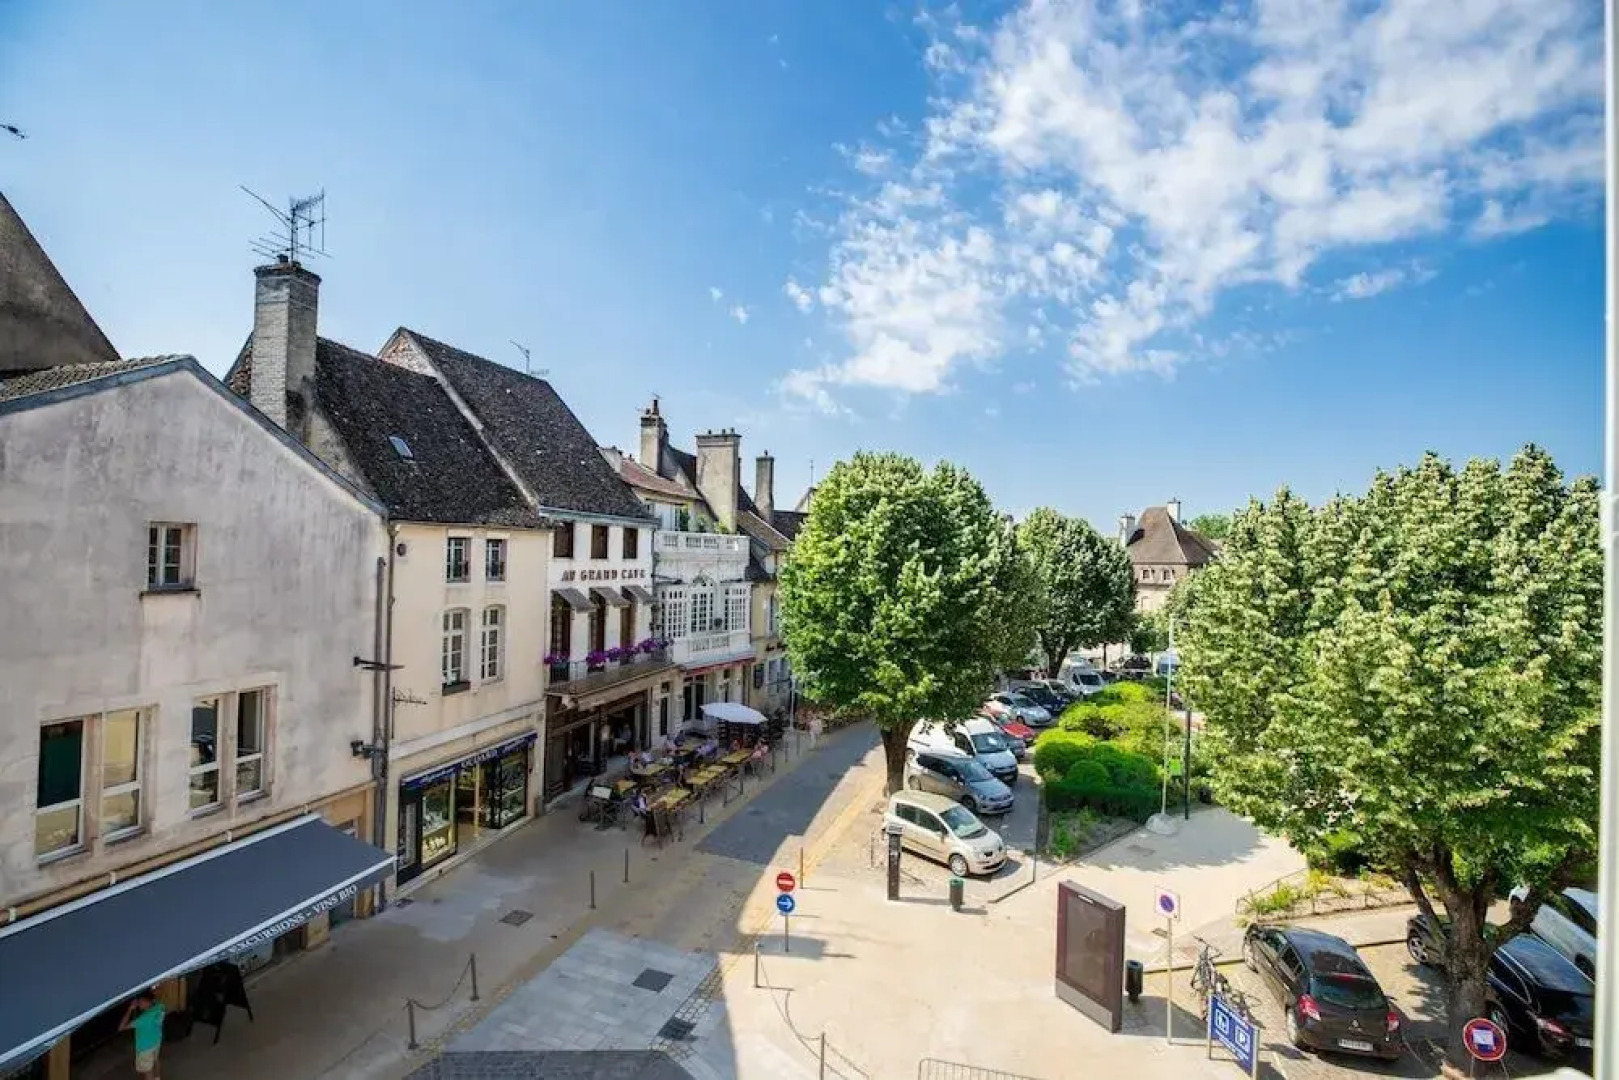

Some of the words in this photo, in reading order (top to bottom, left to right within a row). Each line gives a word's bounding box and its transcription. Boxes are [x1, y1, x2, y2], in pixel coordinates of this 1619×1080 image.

[562, 569, 576, 581] AU
[580, 569, 618, 581] GRAND
[228, 912, 305, 953] EXCURSIONS
[313, 895, 339, 914] VINS
[340, 884, 357, 900] BIO
